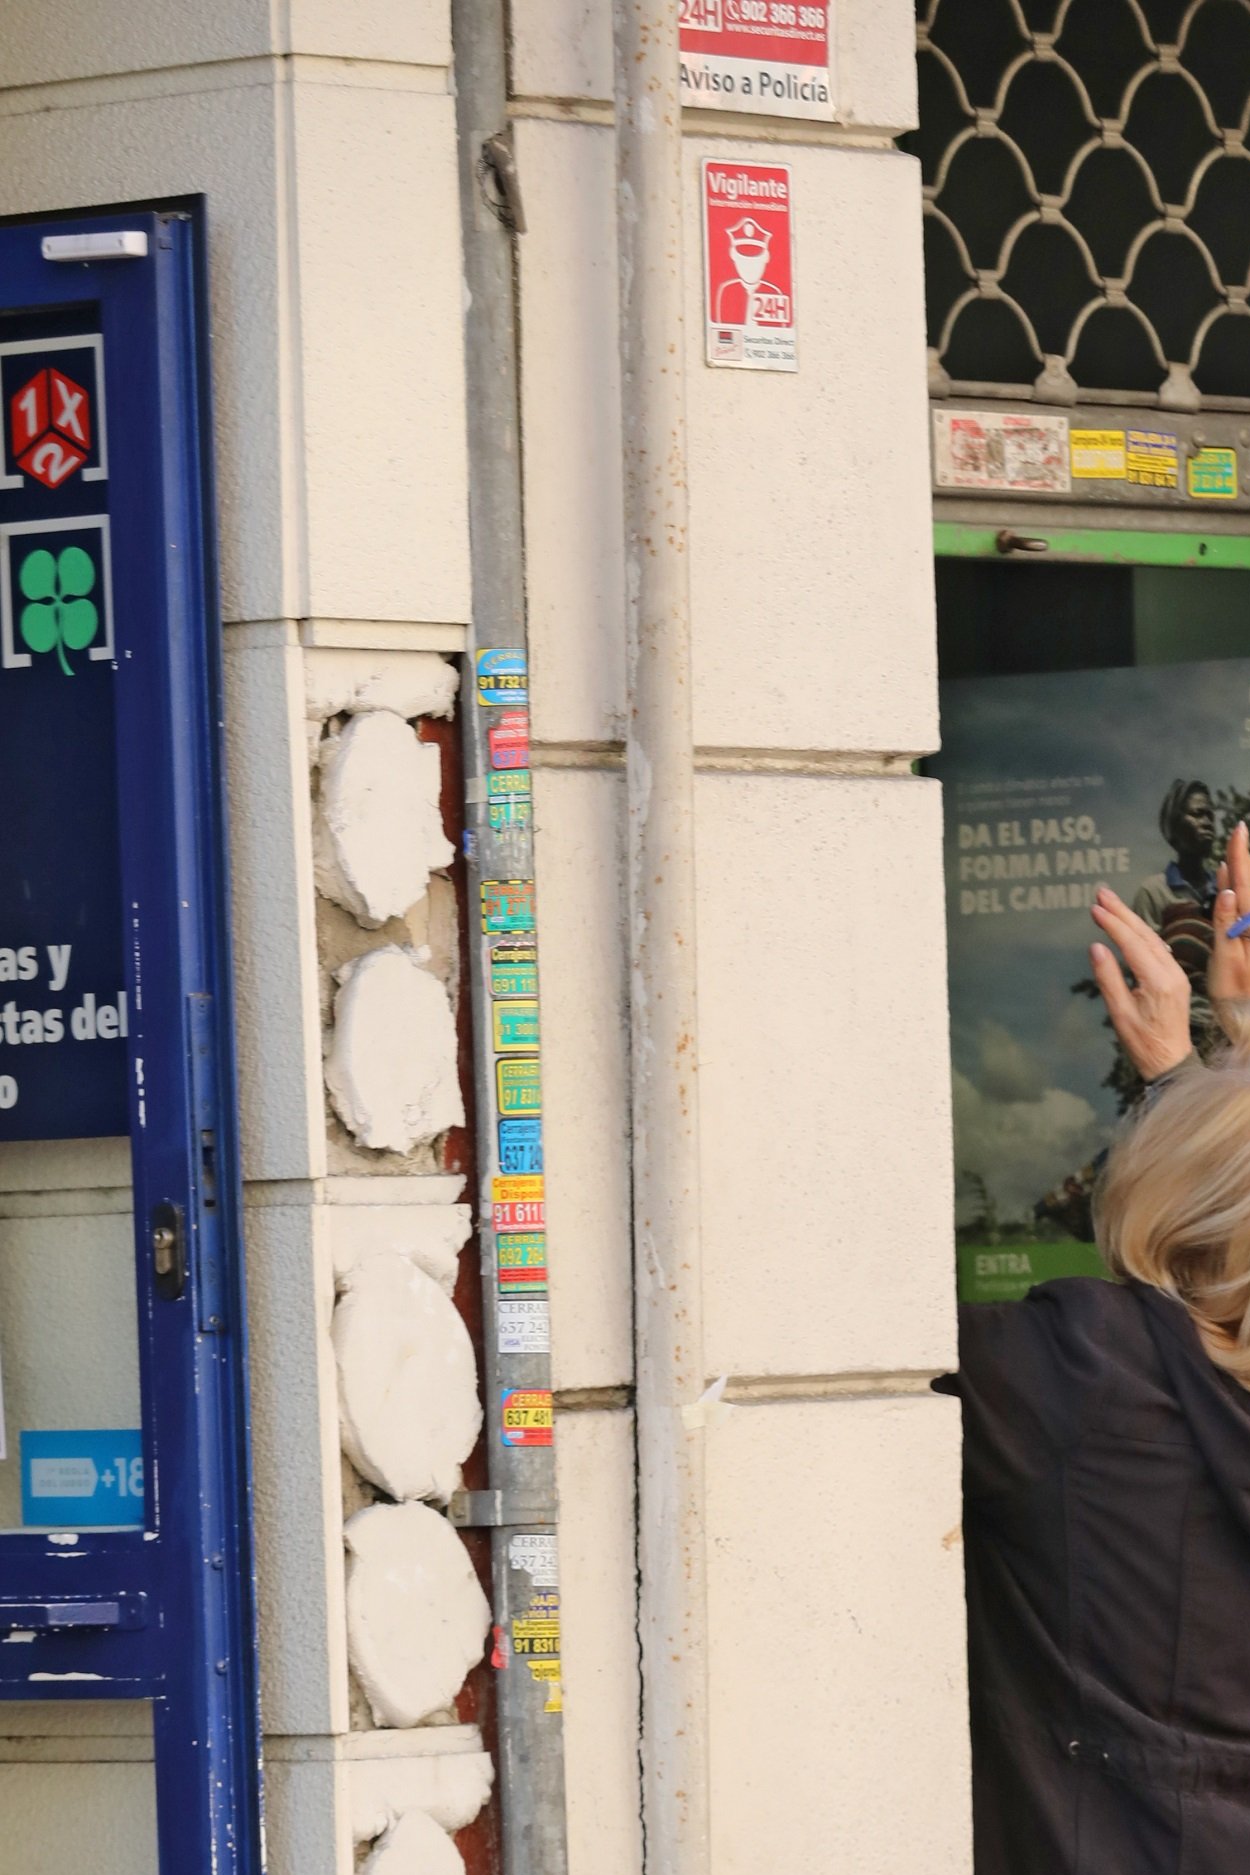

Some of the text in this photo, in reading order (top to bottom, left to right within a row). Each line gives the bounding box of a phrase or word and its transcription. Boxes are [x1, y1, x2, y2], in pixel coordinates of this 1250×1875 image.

[741, 0, 768, 22] 902
[770, 3, 797, 26] 366
[799, 7, 826, 30] 366
[680, 62, 829, 103] Aviso a Policía
[708, 172, 789, 200] Vigilante
[755, 297, 788, 320] 24H
[479, 676, 495, 690] 91
[958, 823, 993, 850] DA
[997, 820, 1025, 847] EL
[959, 847, 1131, 881] FORMA PARTE
[960, 888, 1005, 915] DEL
[47, 944, 73, 992] y
[71, 991, 128, 1041] del
[494, 1205, 511, 1223] 91
[506, 1410, 529, 1426] 637
[514, 1640, 530, 1654] 91
